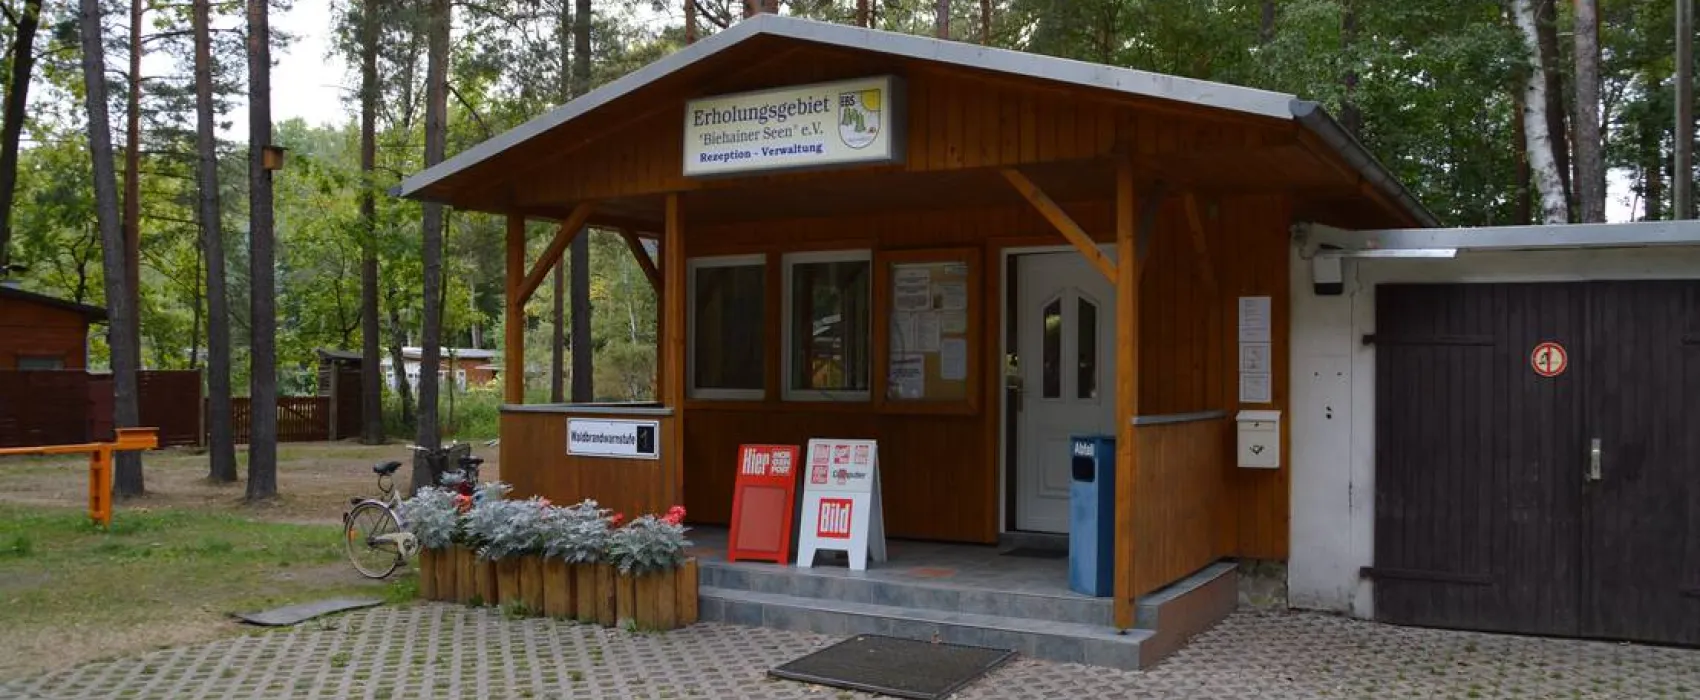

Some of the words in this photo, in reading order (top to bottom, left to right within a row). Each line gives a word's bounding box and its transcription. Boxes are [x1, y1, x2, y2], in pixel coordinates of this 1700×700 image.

[693, 96, 831, 127] Erholungsgebiet
[801, 121, 824, 137] e.V.
[700, 149, 751, 162] Rezeption
[761, 143, 823, 156] Verwaltung
[571, 431, 636, 446] Waldbrandwarnstufe
[1074, 440, 1095, 456] Abfall
[743, 447, 770, 475] Hier
[832, 469, 867, 479] Cputer
[820, 503, 851, 534] Bild
